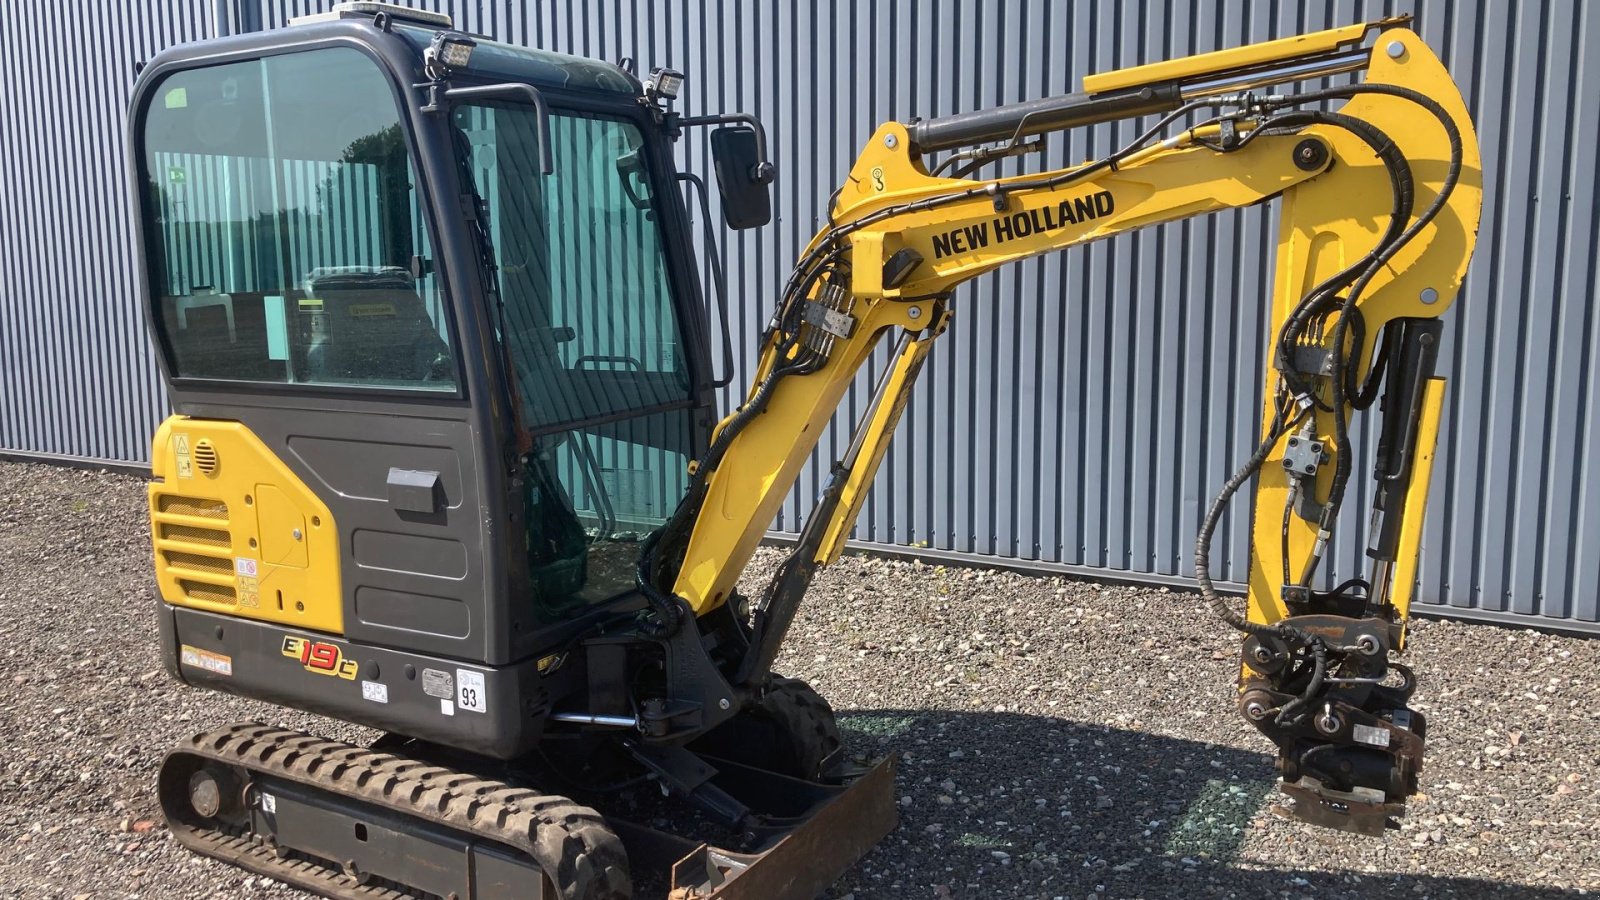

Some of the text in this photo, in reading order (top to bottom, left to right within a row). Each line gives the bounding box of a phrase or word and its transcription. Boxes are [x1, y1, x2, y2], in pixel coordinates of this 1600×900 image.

[932, 190, 1115, 258] NEW HOLLAND
[462, 687, 477, 707] 93
